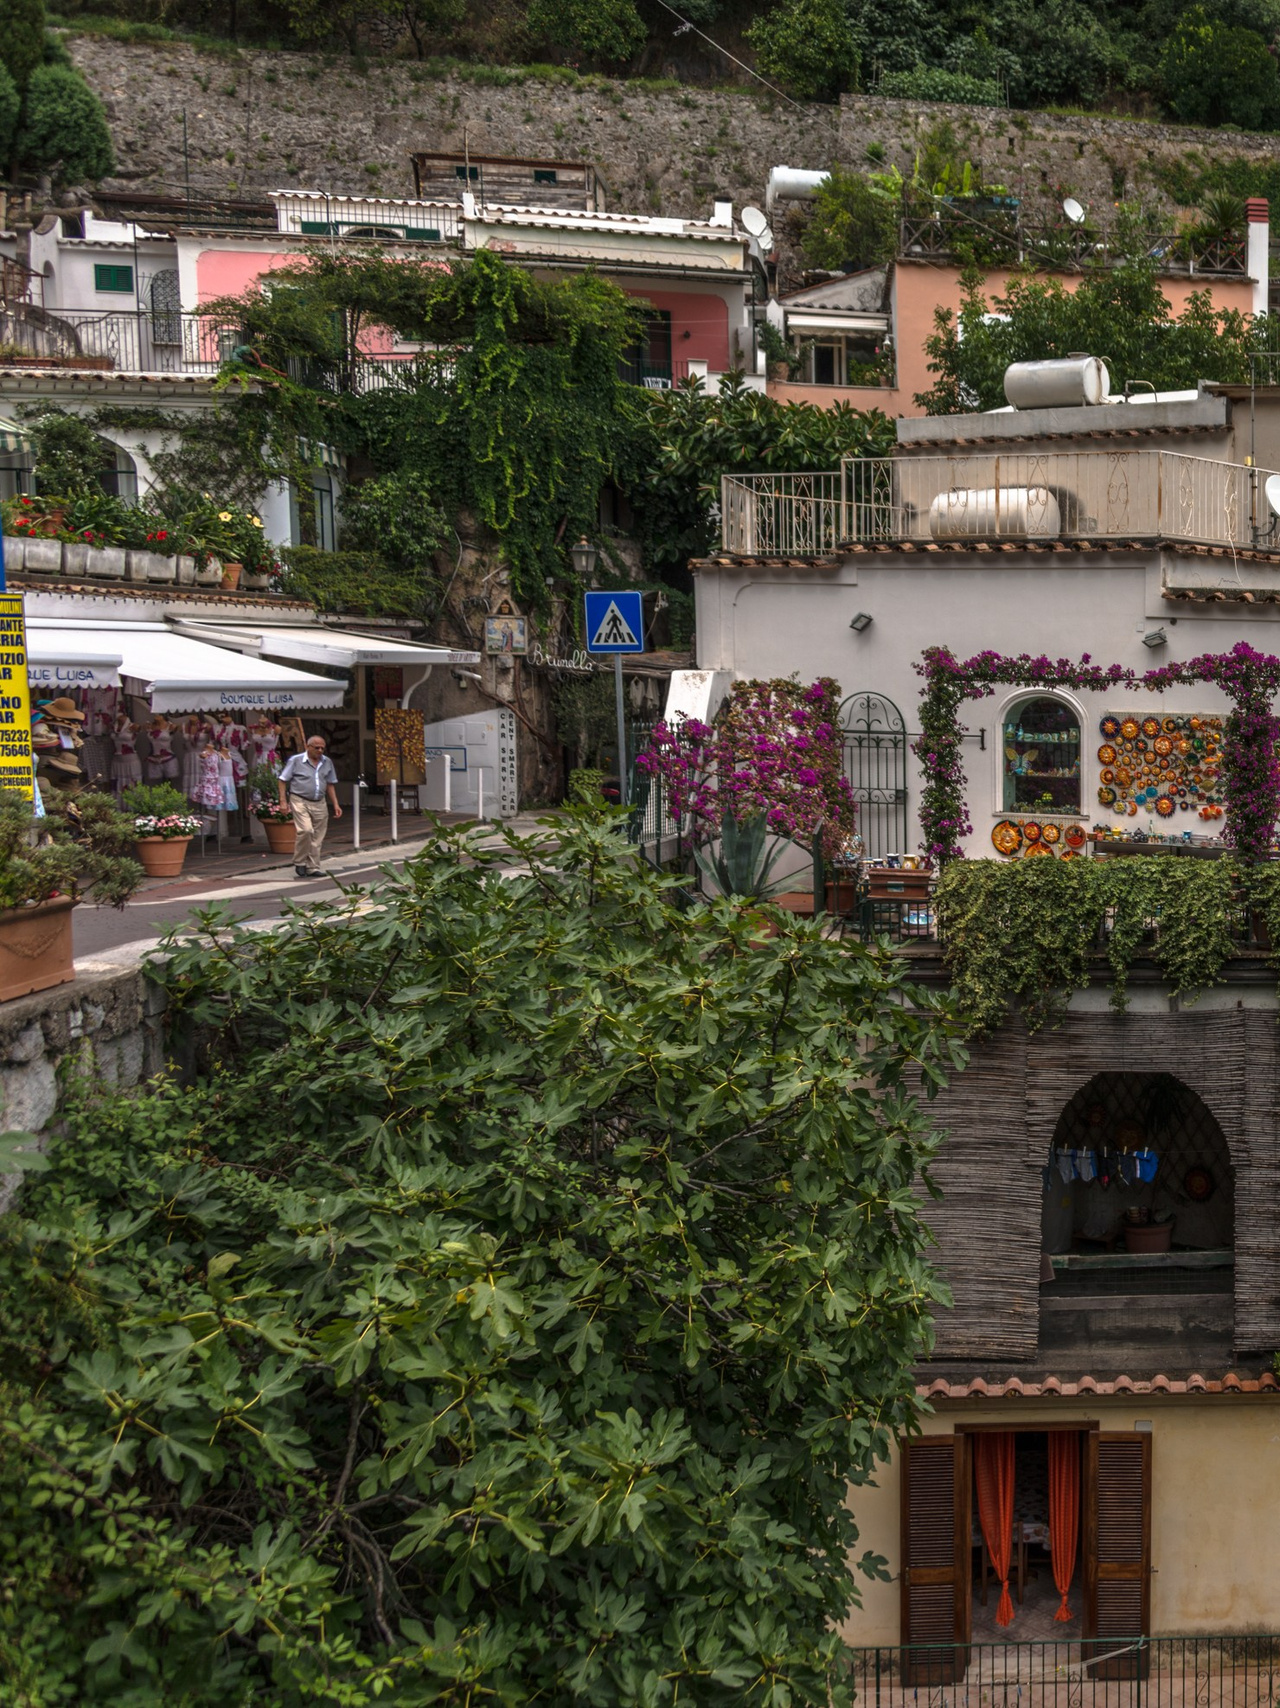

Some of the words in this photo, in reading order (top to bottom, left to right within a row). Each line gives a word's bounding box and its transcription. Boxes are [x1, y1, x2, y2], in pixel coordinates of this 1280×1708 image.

[0, 634, 24, 647] RIA
[527, 642, 594, 671] Brunella
[56, 667, 94, 681] LUISA
[0, 696, 21, 709] NO
[220, 692, 265, 704] BOUTIQUE
[268, 692, 294, 704] LUISA
